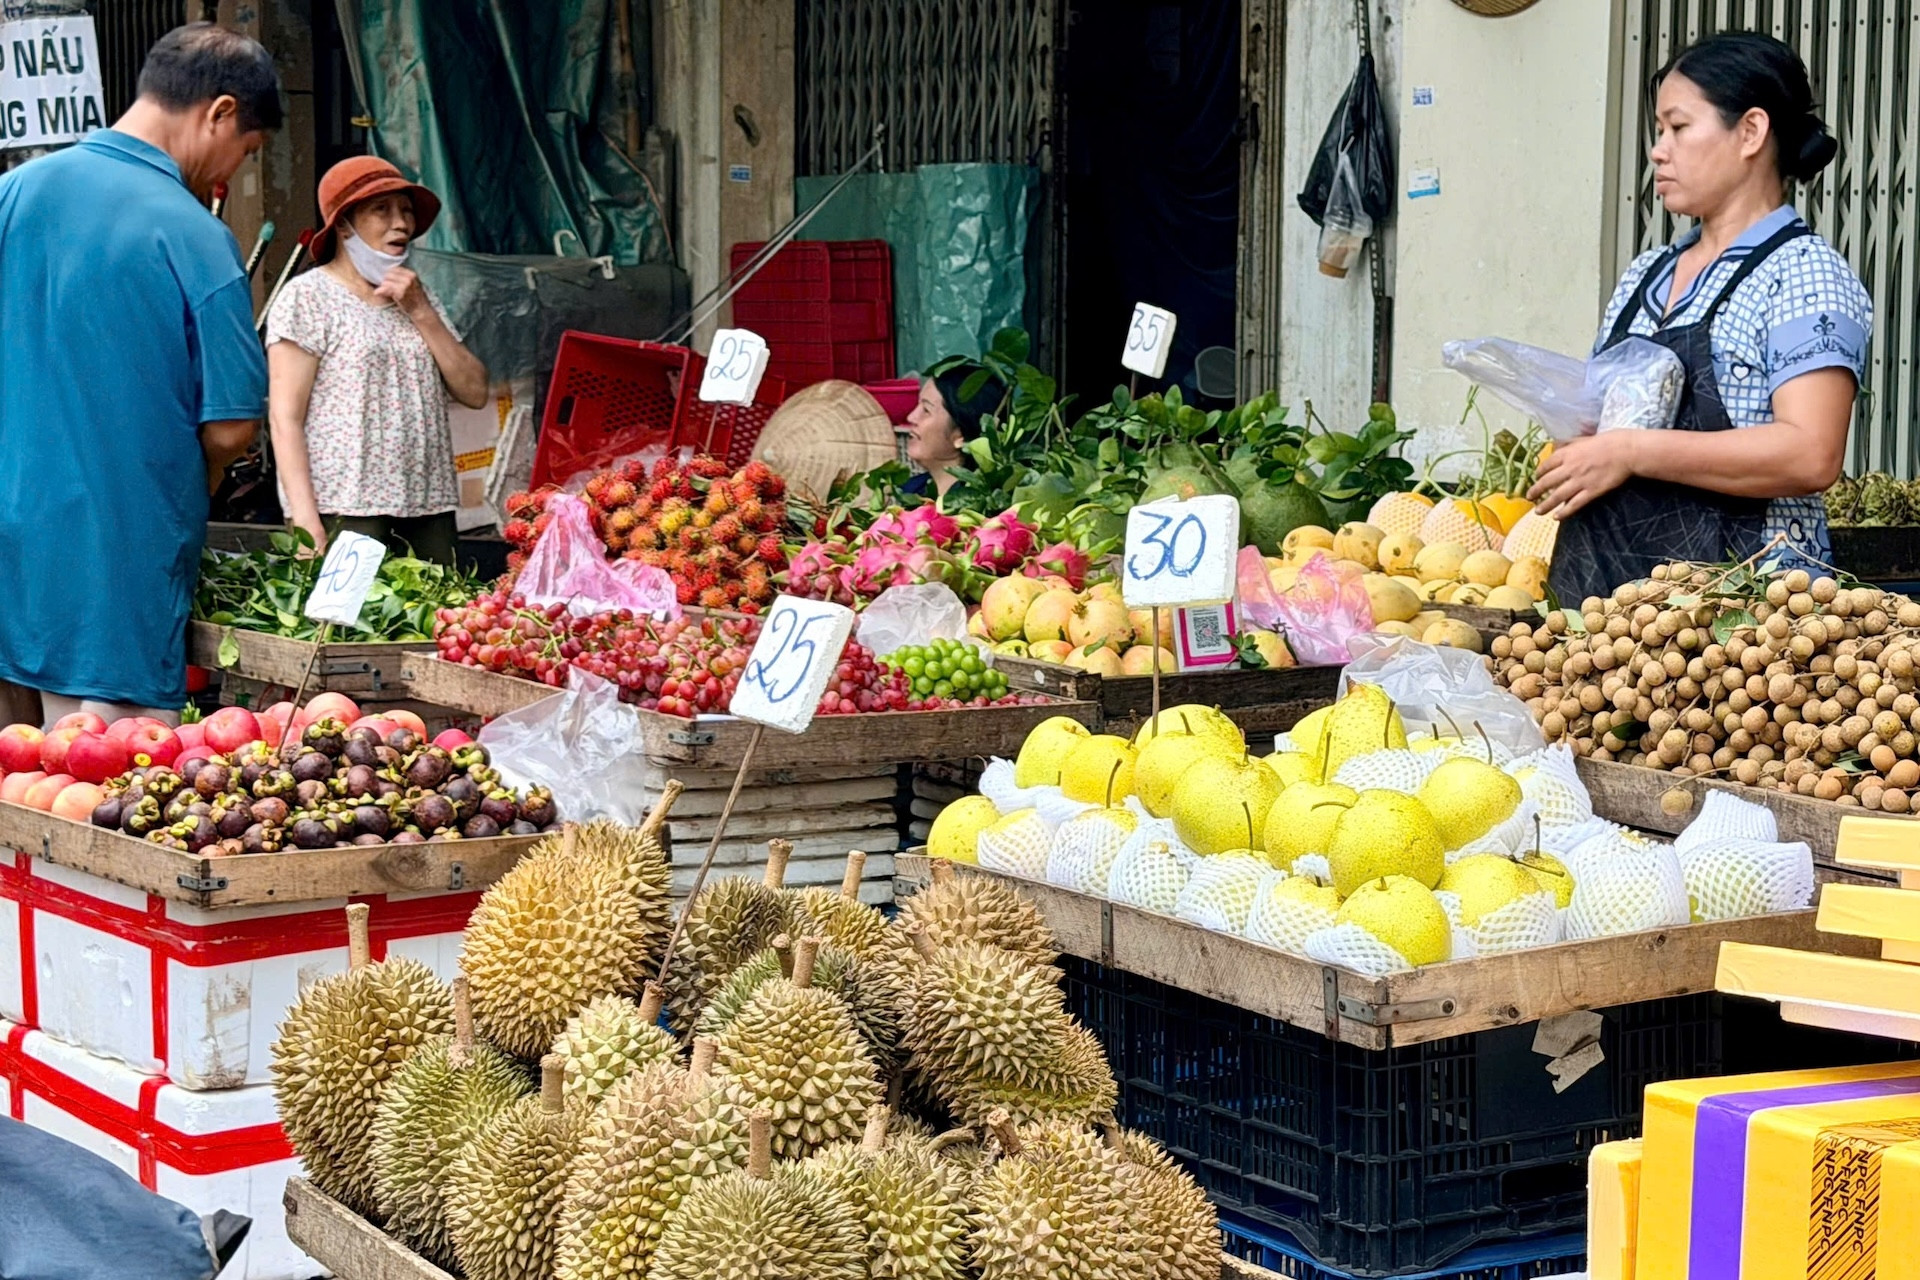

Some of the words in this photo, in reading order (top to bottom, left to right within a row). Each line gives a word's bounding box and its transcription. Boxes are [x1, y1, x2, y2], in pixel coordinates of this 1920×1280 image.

[13, 25, 84, 78] NẤU
[37, 86, 103, 135] MÍA
[1128, 308, 1169, 352] 35
[710, 336, 756, 381] 25
[319, 537, 371, 595] 45
[1127, 510, 1207, 581] 30
[744, 607, 836, 704] 25
